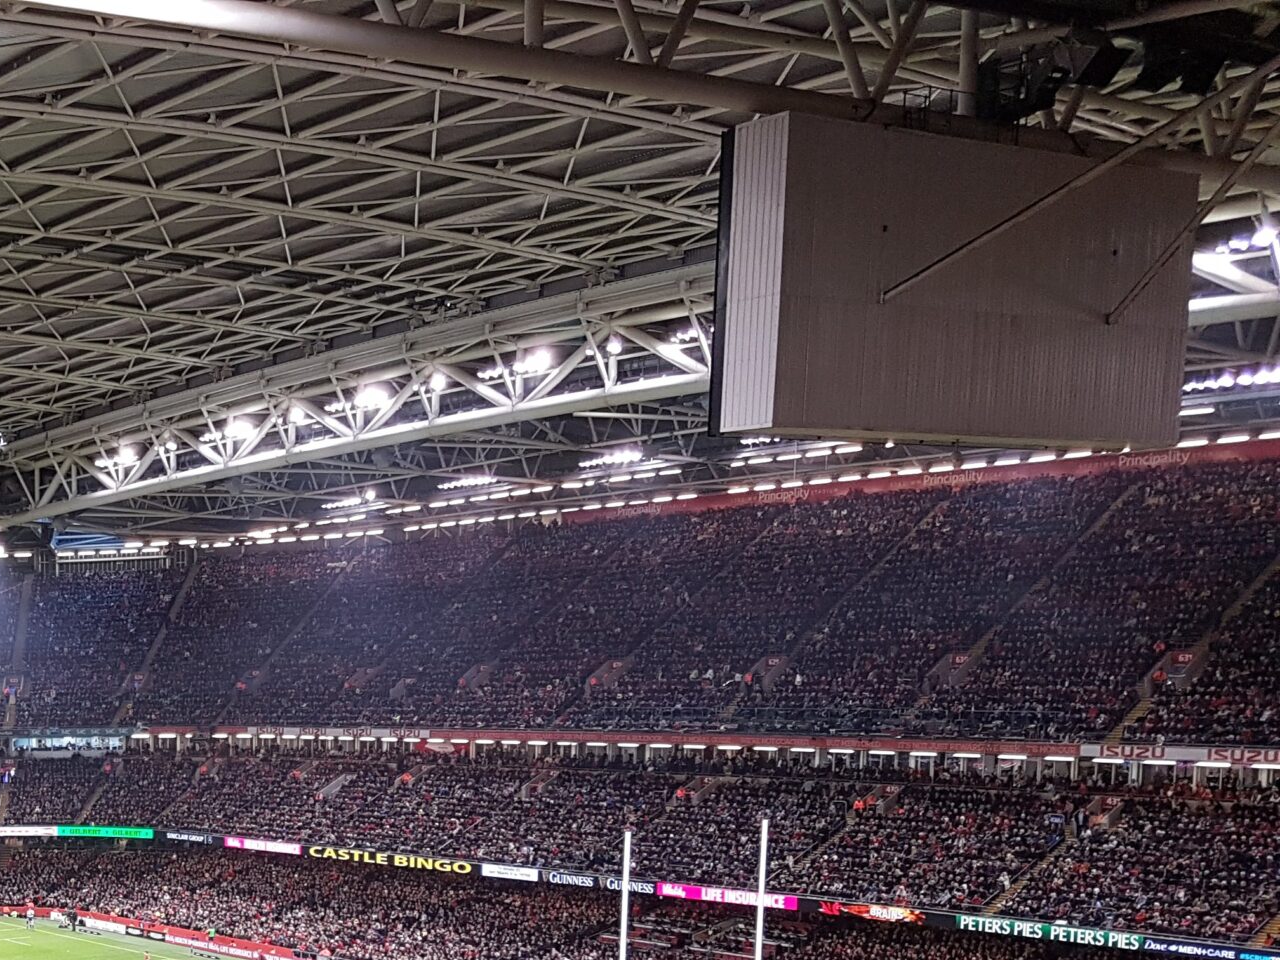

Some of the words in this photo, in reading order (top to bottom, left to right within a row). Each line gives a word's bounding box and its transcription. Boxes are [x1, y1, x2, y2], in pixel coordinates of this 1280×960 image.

[1118, 451, 1190, 467] Principality
[923, 469, 983, 487] Principality
[759, 487, 810, 502] Principality
[616, 503, 662, 517] Principality
[258, 727, 284, 735] ISUZU
[299, 727, 327, 736] ISUZU
[343, 728, 370, 737] ISUZU
[389, 729, 420, 738] ISUZU
[1100, 745, 1165, 758] ISUZU
[1207, 748, 1280, 763] ISUZU
[309, 846, 388, 864] CASTLE
[394, 855, 472, 874] BINGO
[549, 873, 594, 887] GUINNESS
[607, 879, 654, 894] GUNNESS
[701, 887, 723, 902] LIFE
[869, 907, 904, 920] BRAINS
[959, 916, 1010, 935] PETER'S
[1013, 922, 1043, 938] PIES
[1050, 926, 1104, 946] PETER'S
[1108, 932, 1139, 950] PIES
[1144, 939, 1167, 951] Dove
[1178, 945, 1235, 959] MEN+CARE
